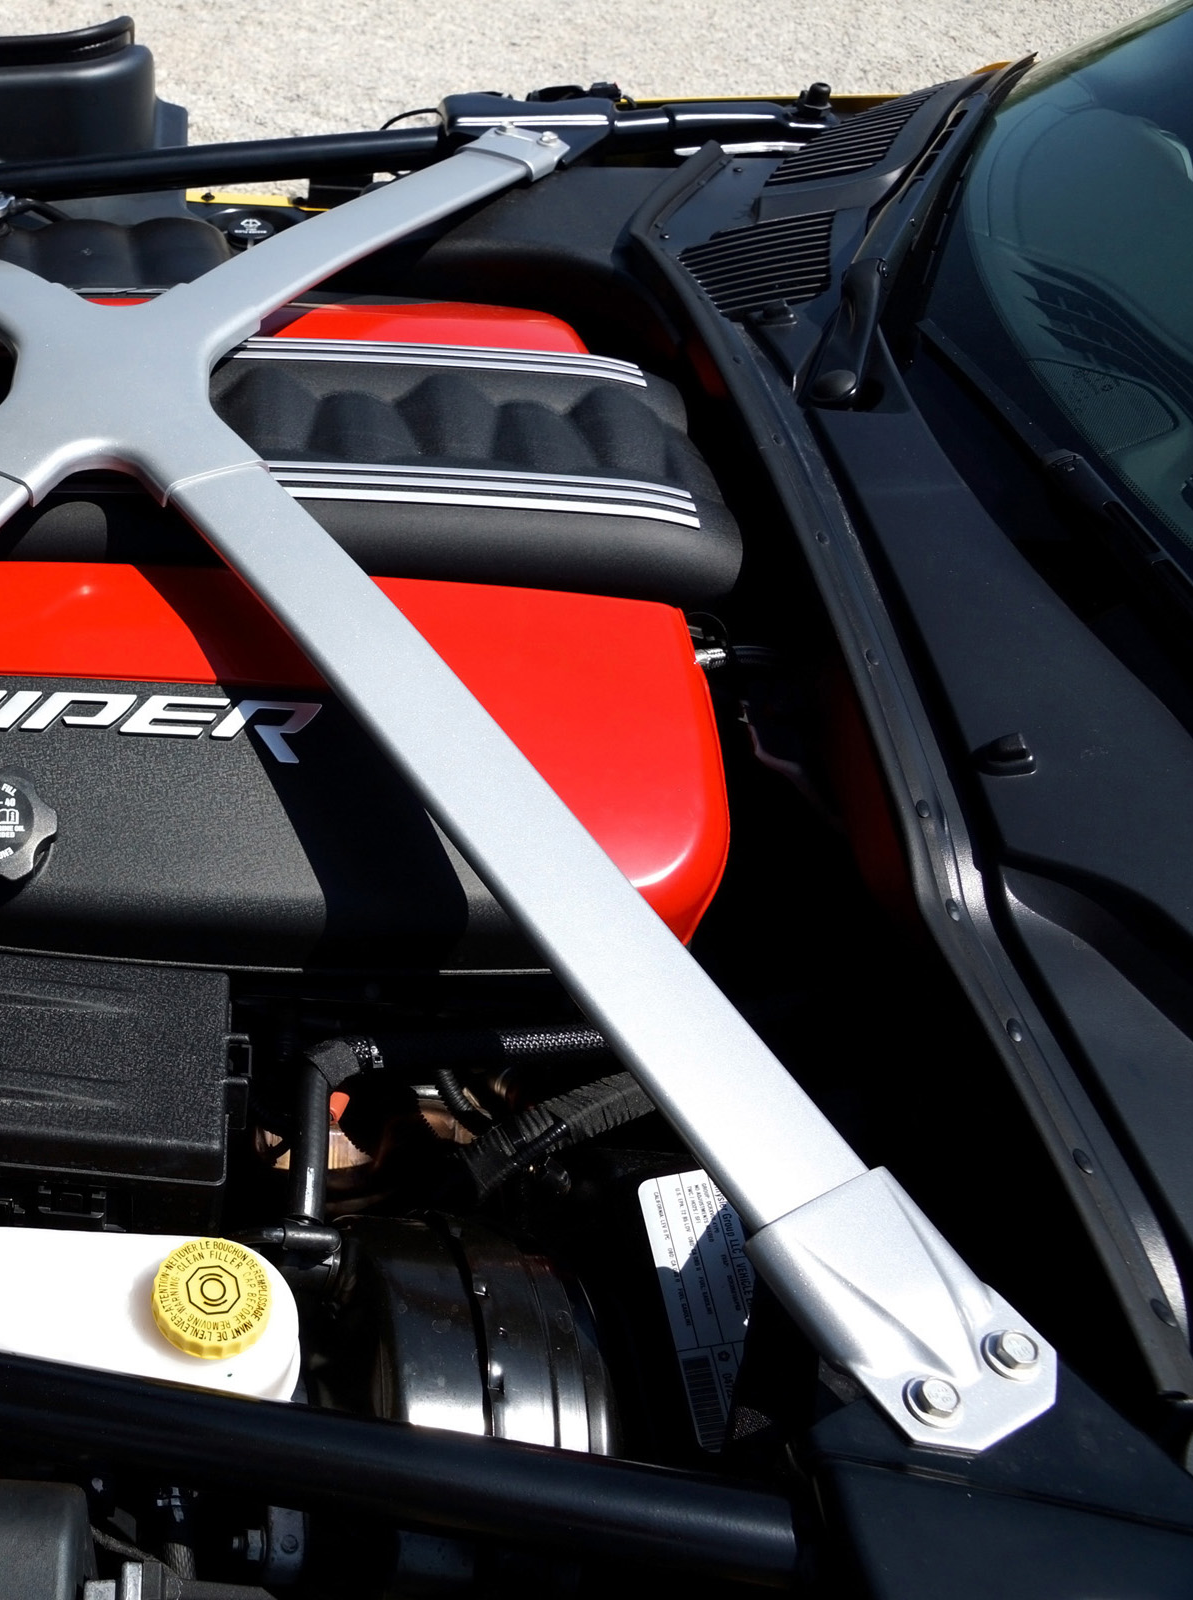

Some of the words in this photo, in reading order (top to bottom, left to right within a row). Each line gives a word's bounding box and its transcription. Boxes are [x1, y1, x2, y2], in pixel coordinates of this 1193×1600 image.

[1, 783, 17, 796] FILL
[696, 1191, 709, 1223] ADJUSTMENTS
[200, 1241, 211, 1250] LE
[214, 1241, 248, 1261] BOUCHON
[721, 1213, 736, 1237] Group
[729, 1238, 742, 1255] LLC
[736, 1262, 753, 1295] VEHICLE
[177, 1252, 205, 1272] CLEAN
[210, 1250, 243, 1270] FILLER
[242, 1271, 256, 1289] CAP
[236, 1292, 258, 1325] BEFORE
[217, 1332, 228, 1342] DE
[231, 1321, 254, 1339] AVANT
